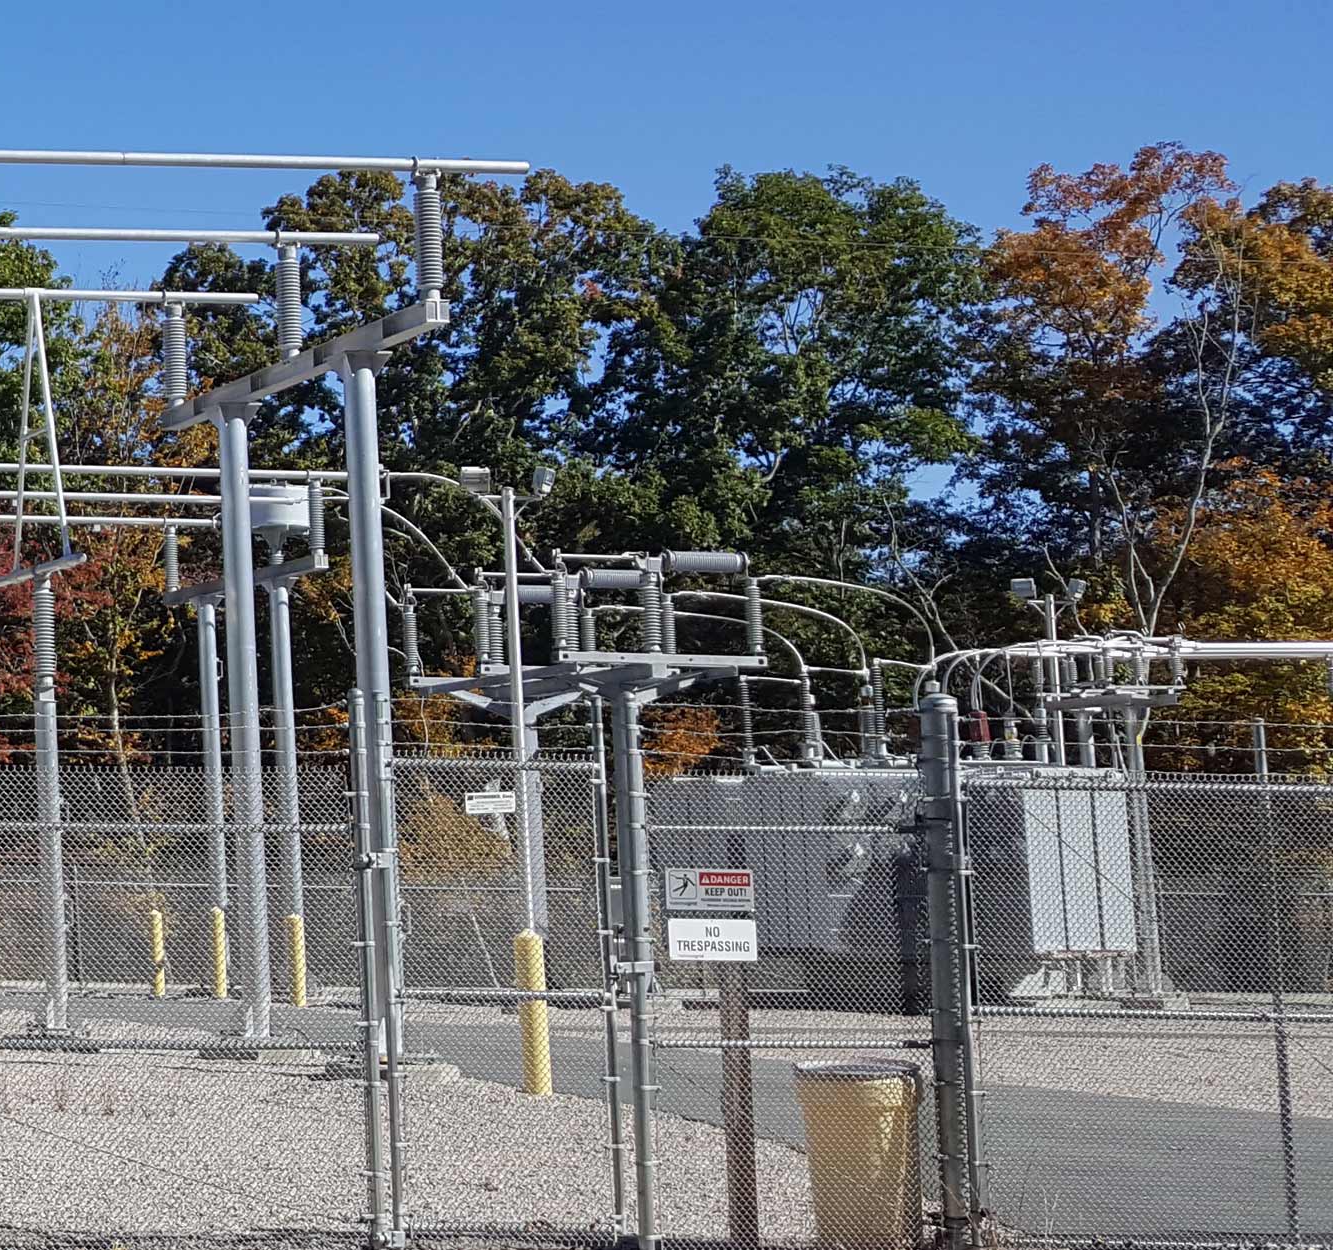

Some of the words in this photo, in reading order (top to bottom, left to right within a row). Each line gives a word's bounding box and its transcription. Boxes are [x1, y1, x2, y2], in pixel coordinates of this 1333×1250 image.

[710, 875, 749, 884] DANGER
[704, 887, 725, 897] KEEP
[727, 887, 747, 897] OUT!
[705, 926, 720, 938] NO
[676, 940, 750, 952] TRESPASSING
